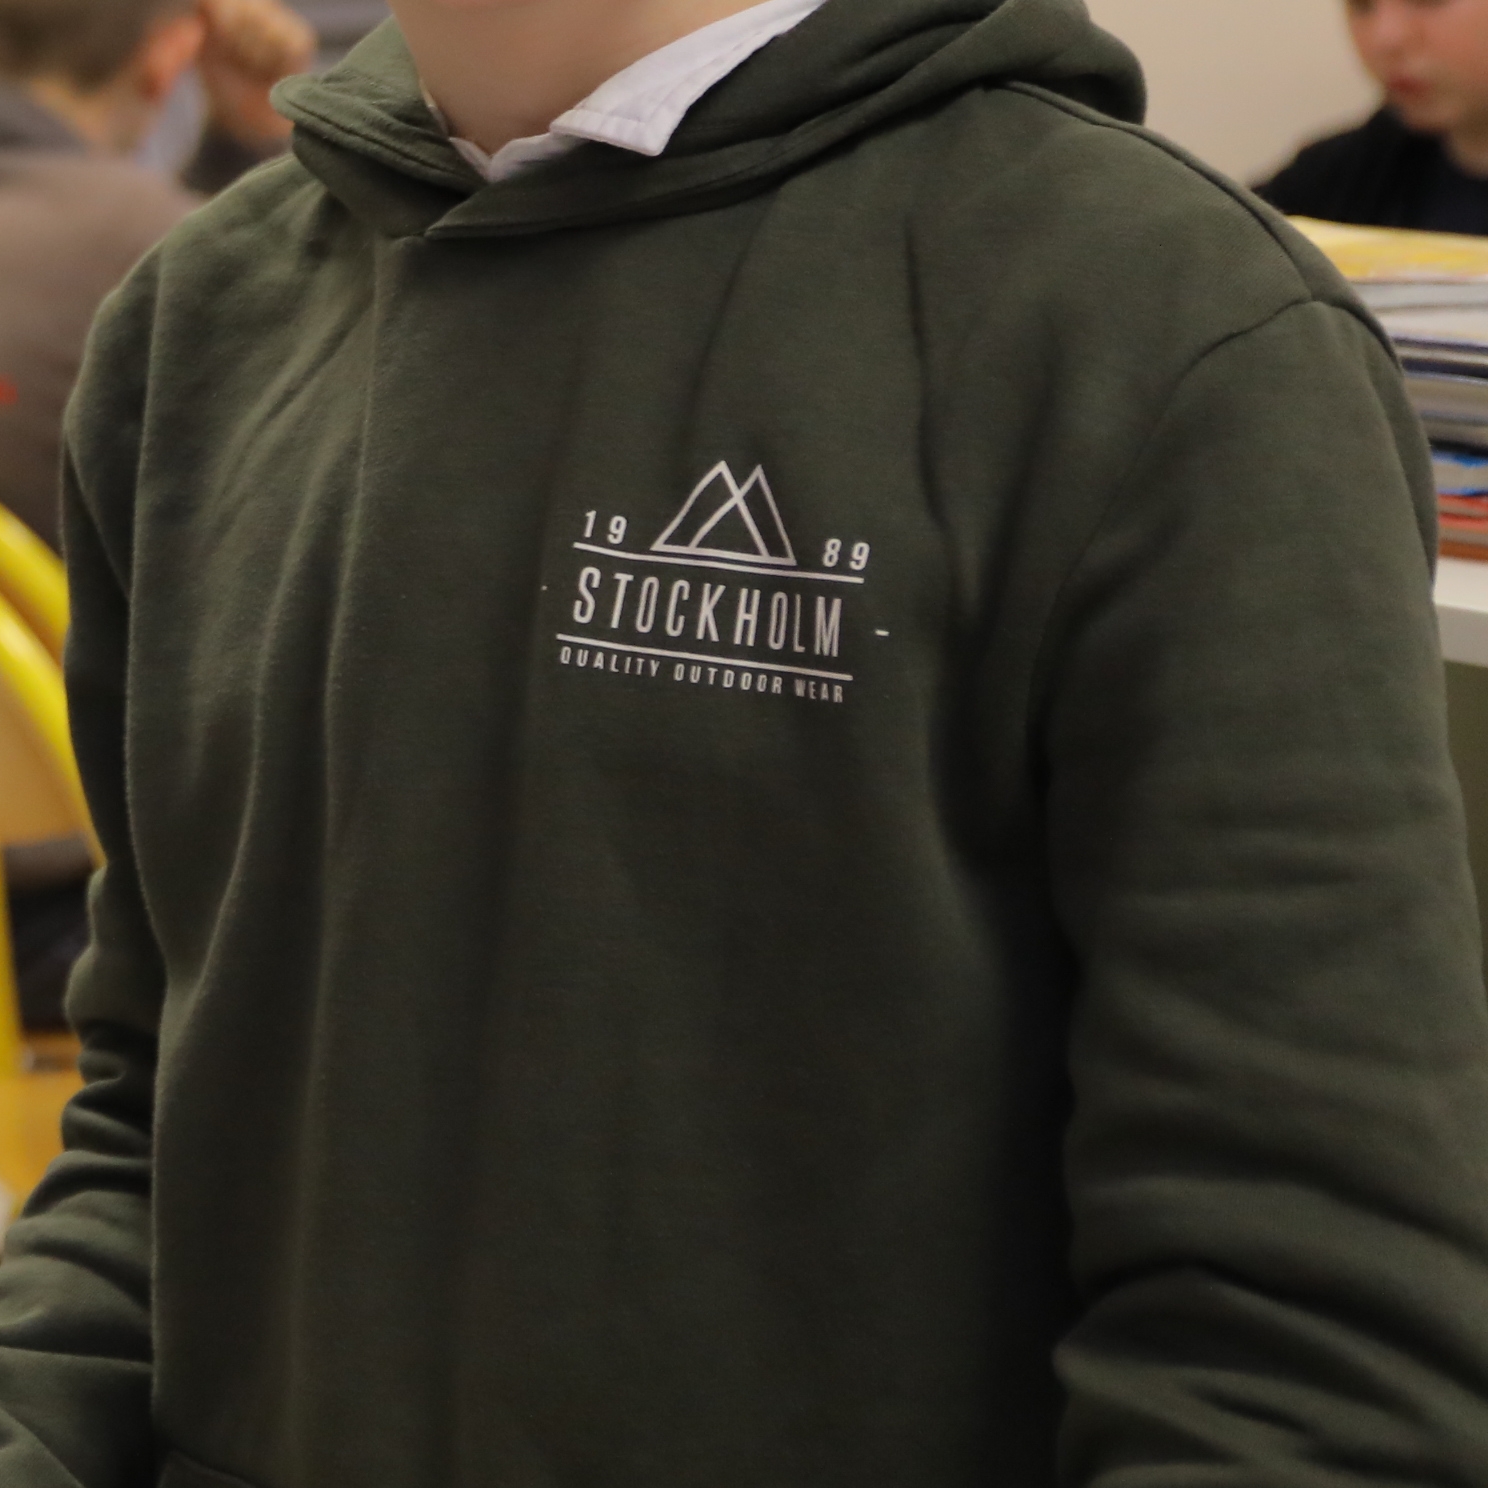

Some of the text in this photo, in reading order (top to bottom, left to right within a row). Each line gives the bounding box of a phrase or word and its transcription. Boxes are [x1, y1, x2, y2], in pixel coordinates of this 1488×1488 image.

[572, 565, 843, 658] STOCKHOLM
[559, 645, 844, 704] QUALITY OUTDOOR WEAR
